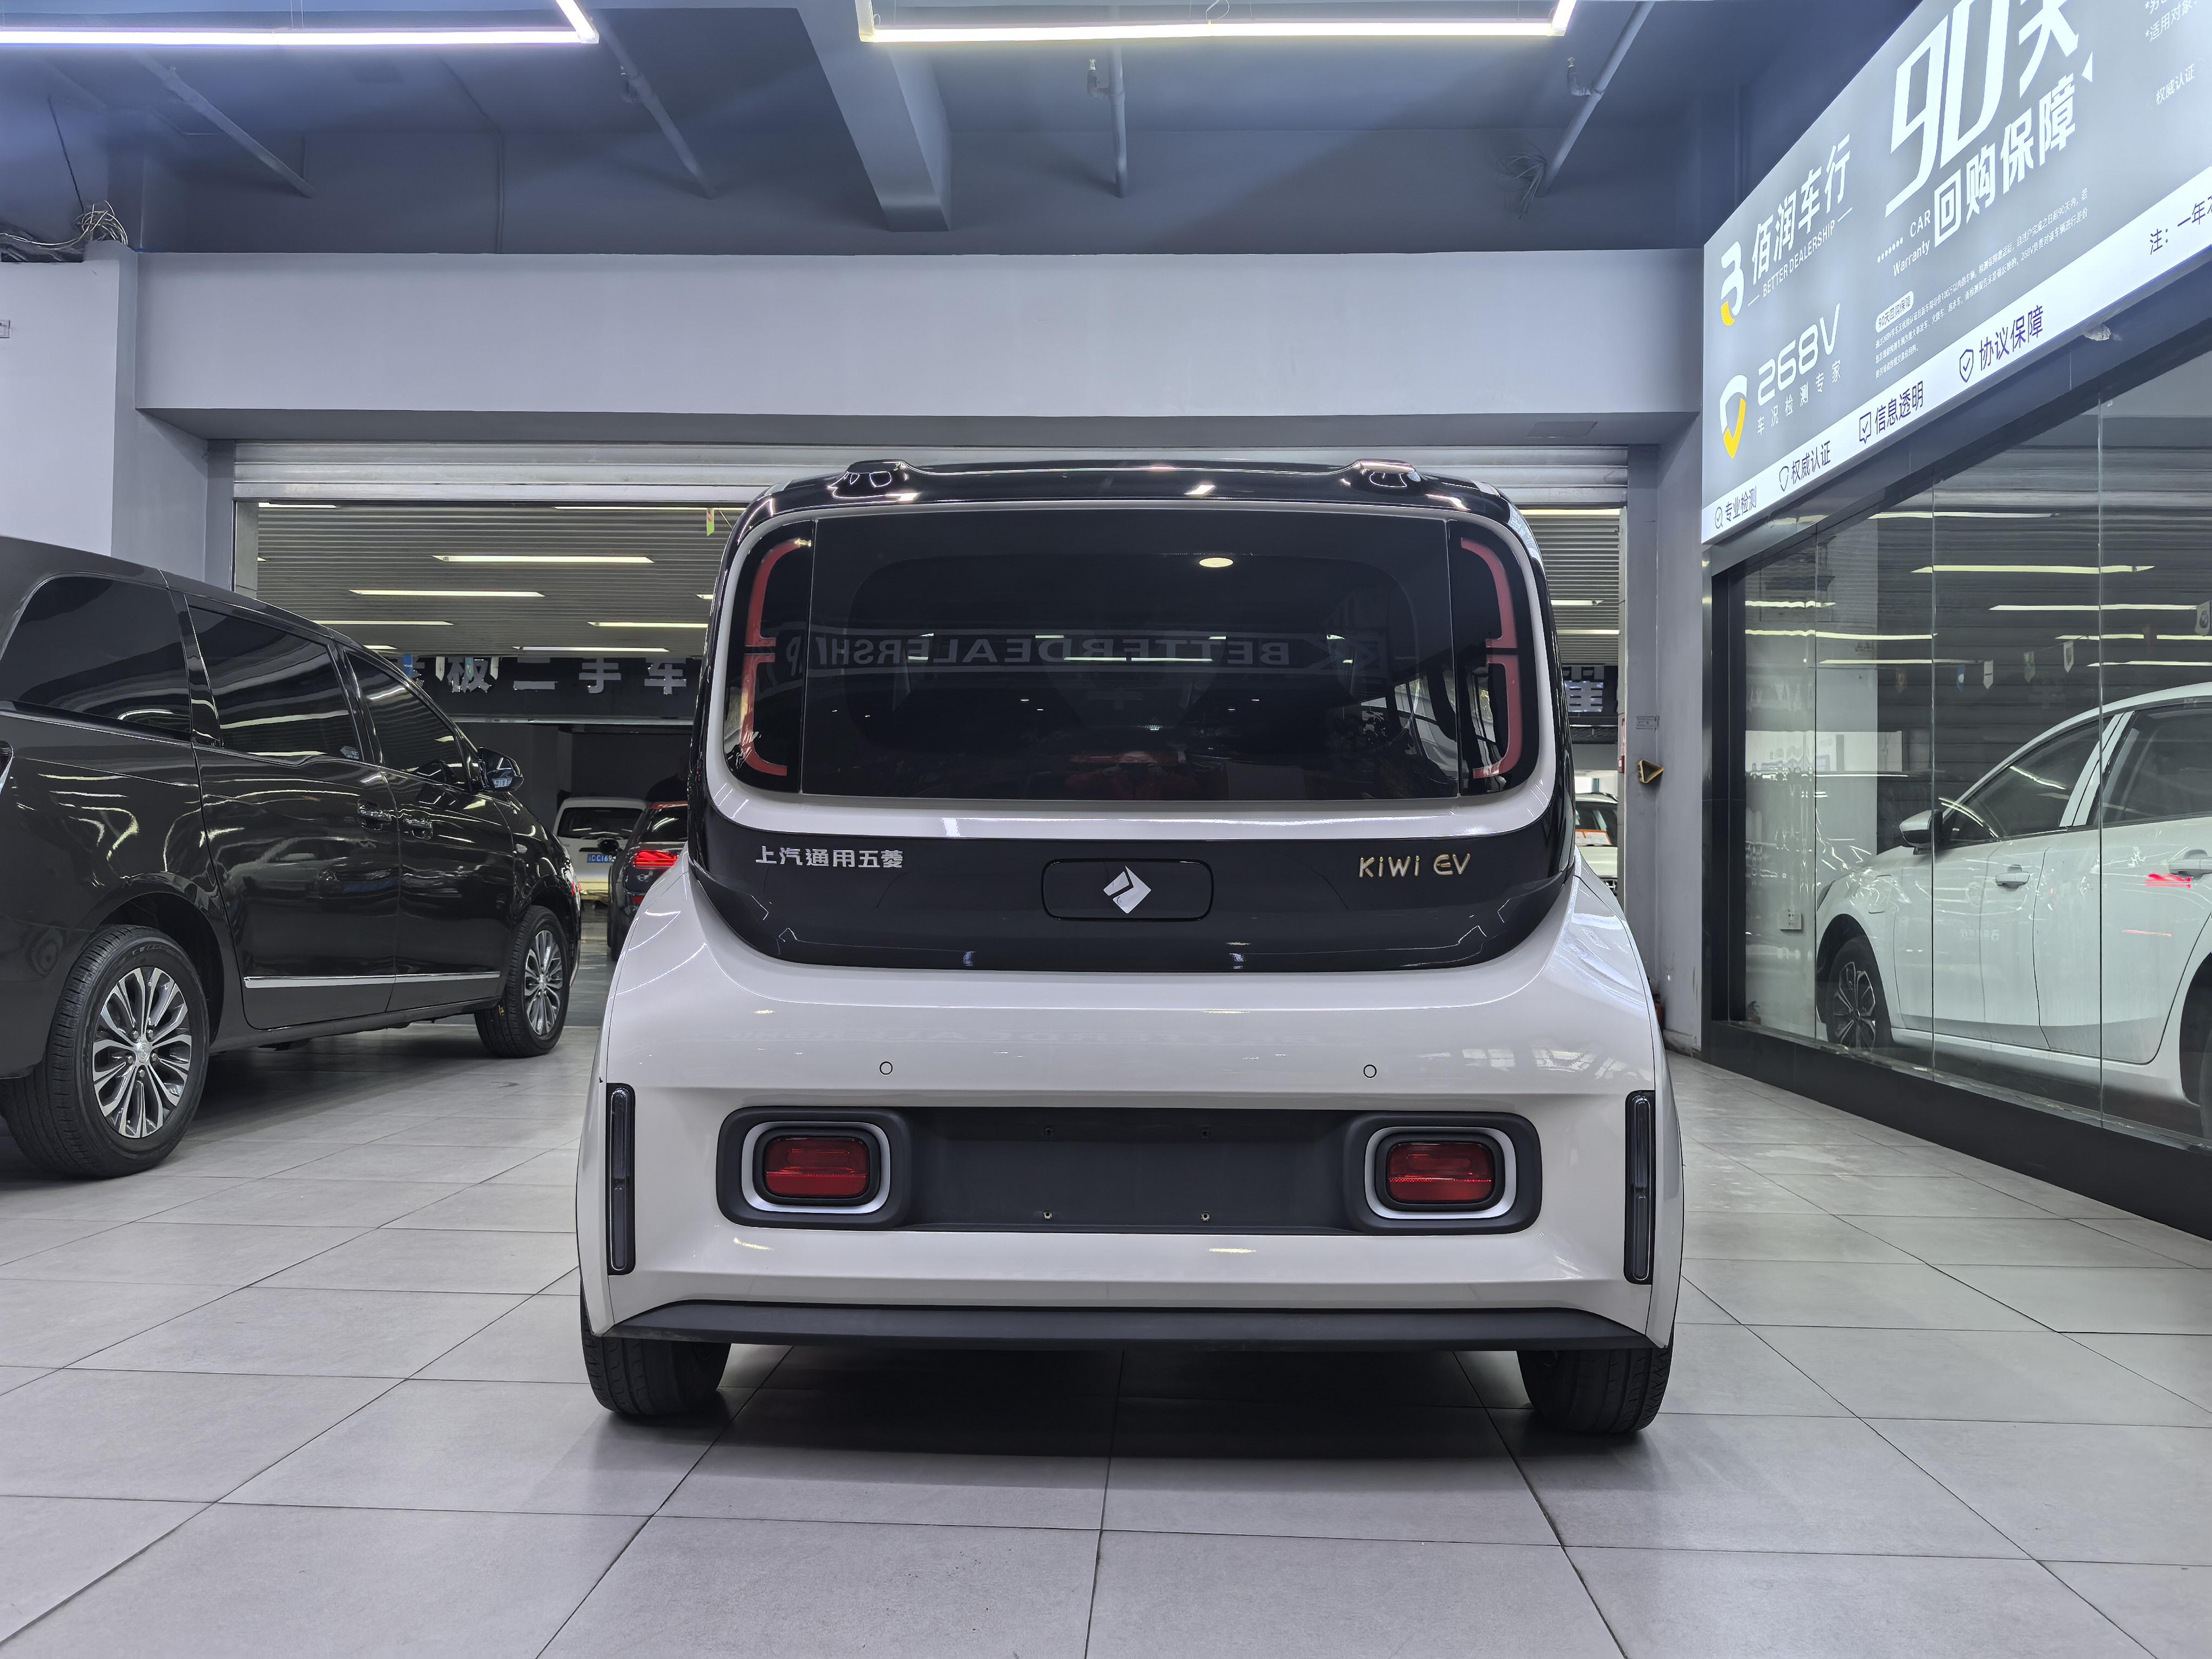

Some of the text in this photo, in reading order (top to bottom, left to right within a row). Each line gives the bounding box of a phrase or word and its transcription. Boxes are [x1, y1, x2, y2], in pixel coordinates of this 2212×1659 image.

[2156, 63, 2195, 105] 权威认证
[1934, 72, 2075, 248] 回购保障
[1751, 133, 1851, 286] 佰润车行
[1910, 209, 1931, 238] CAR
[1763, 219, 1836, 298] BETTER DEALERSHIP
[1892, 239, 1931, 276] Warranty
[1758, 303, 1840, 406] 268V
[1978, 304, 2045, 371] 协议保障
[1757, 360, 1840, 435] 车况检测专家
[1875, 380, 1924, 435] 信息透明
[1790, 441, 1831, 484] 权威认证
[1724, 485, 1757, 522] 专业检测
[756, 846, 903, 868] 上汽通用五菱
[1433, 853, 1471, 875] EV
